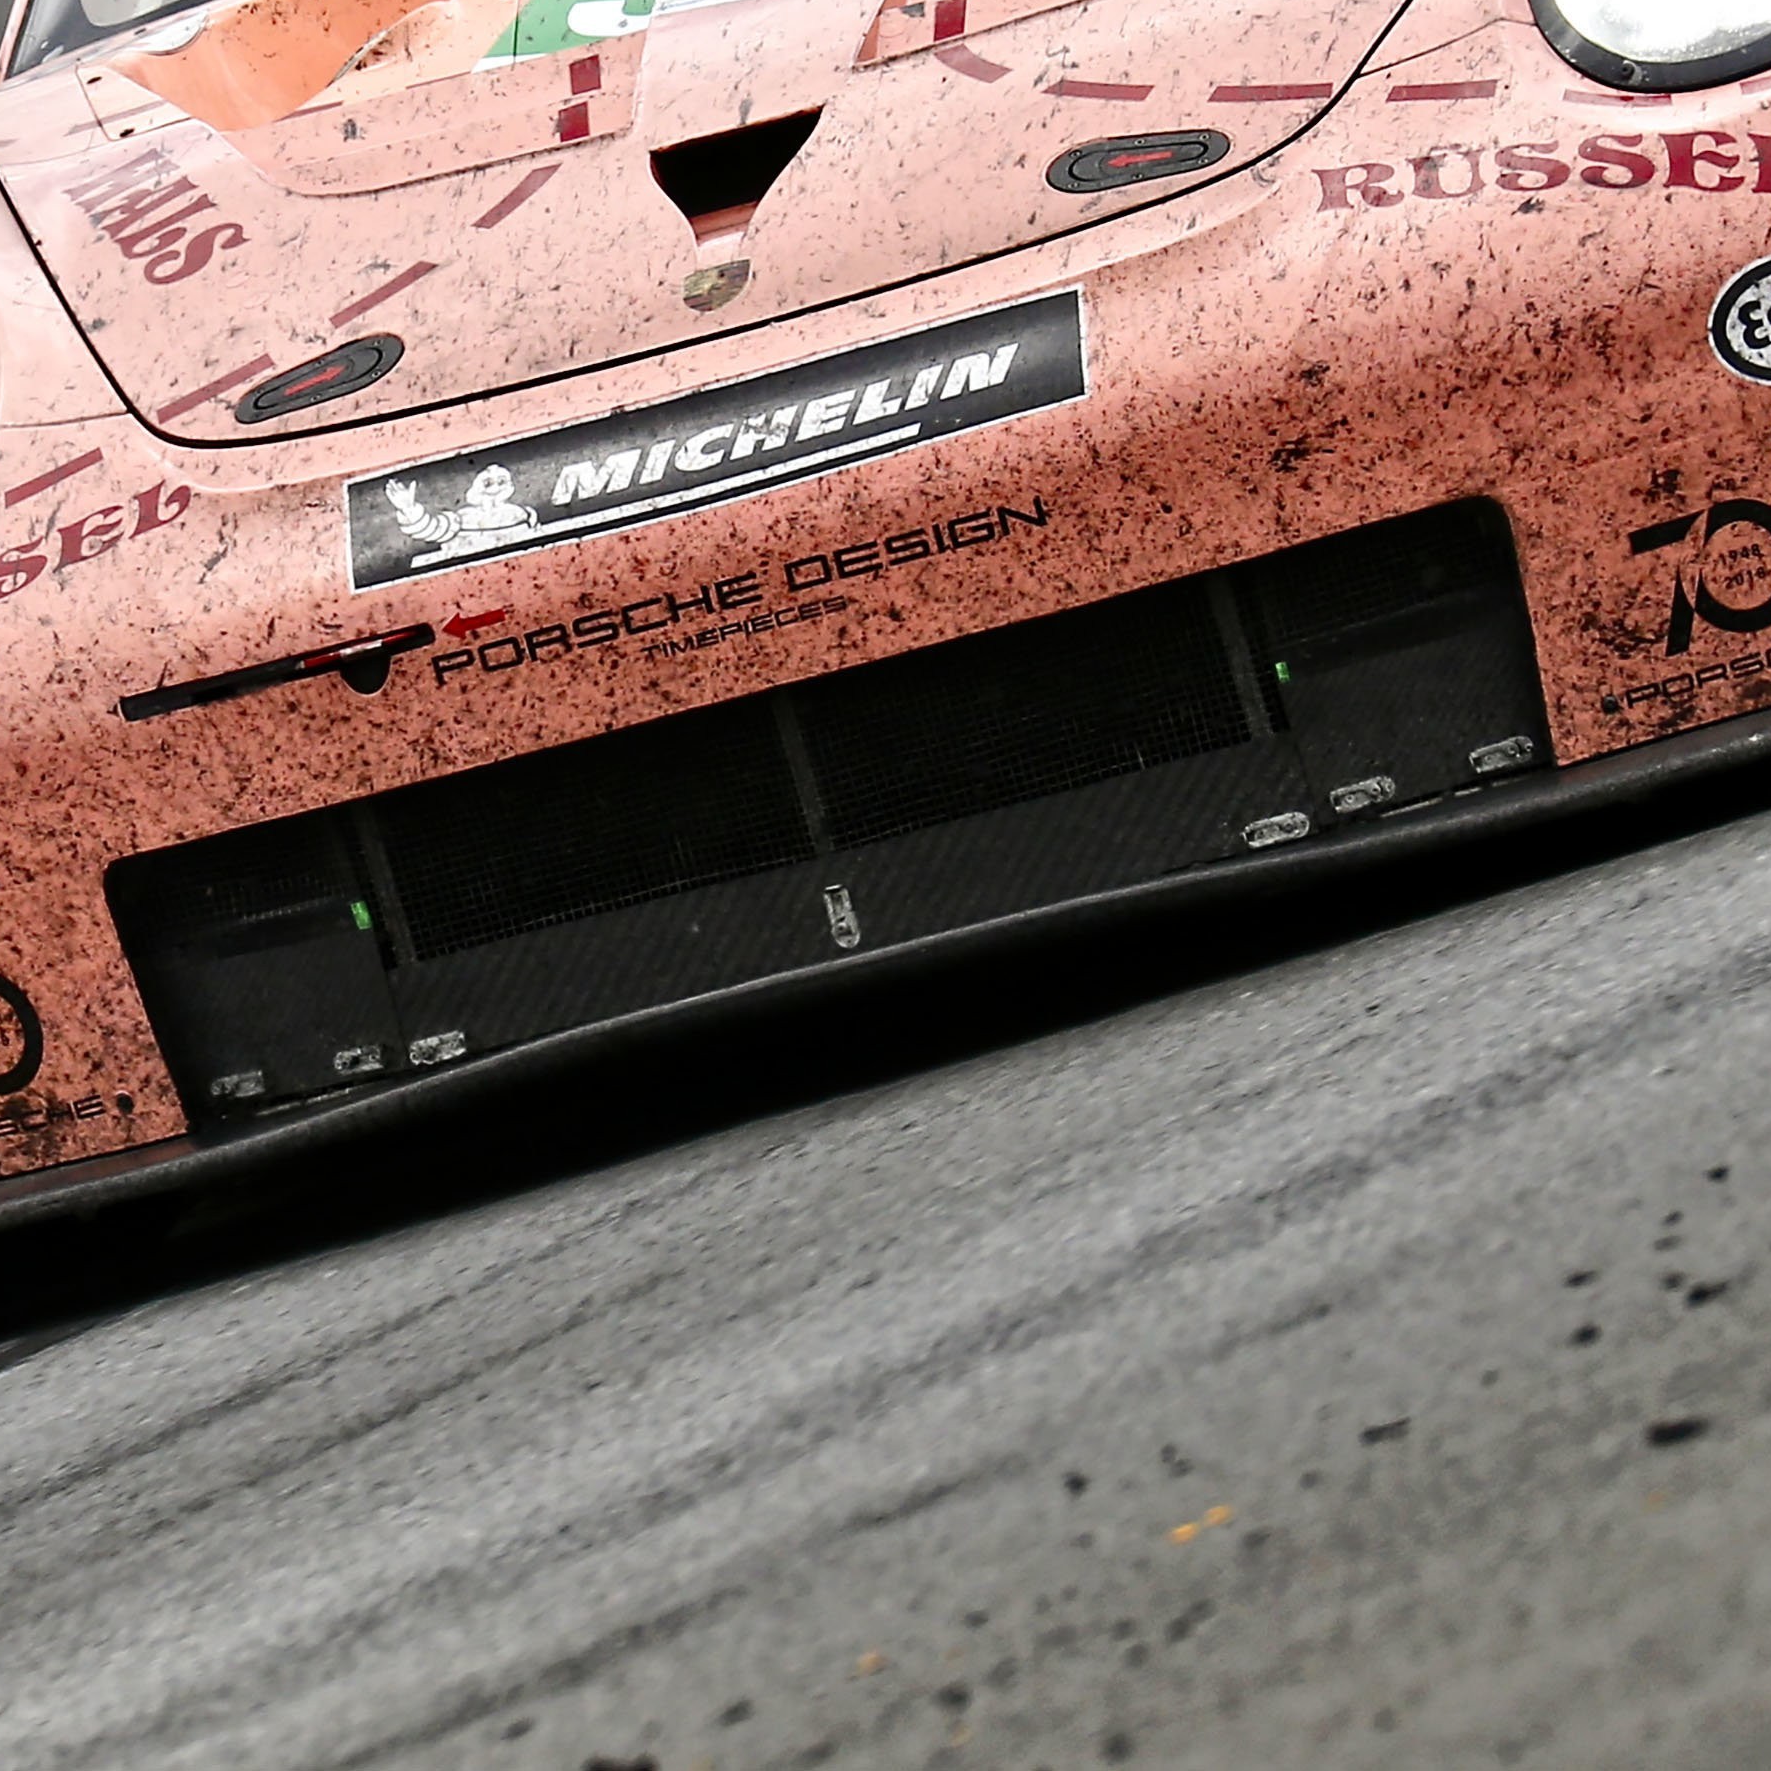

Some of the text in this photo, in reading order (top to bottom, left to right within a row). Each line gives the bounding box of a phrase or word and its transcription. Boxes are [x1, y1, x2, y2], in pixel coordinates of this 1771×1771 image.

[550, 342, 1021, 506] MICHELIN
[432, 496, 1049, 687] PORSCHE DESIGN
[640, 594, 849, 662] TIMEPIECES
